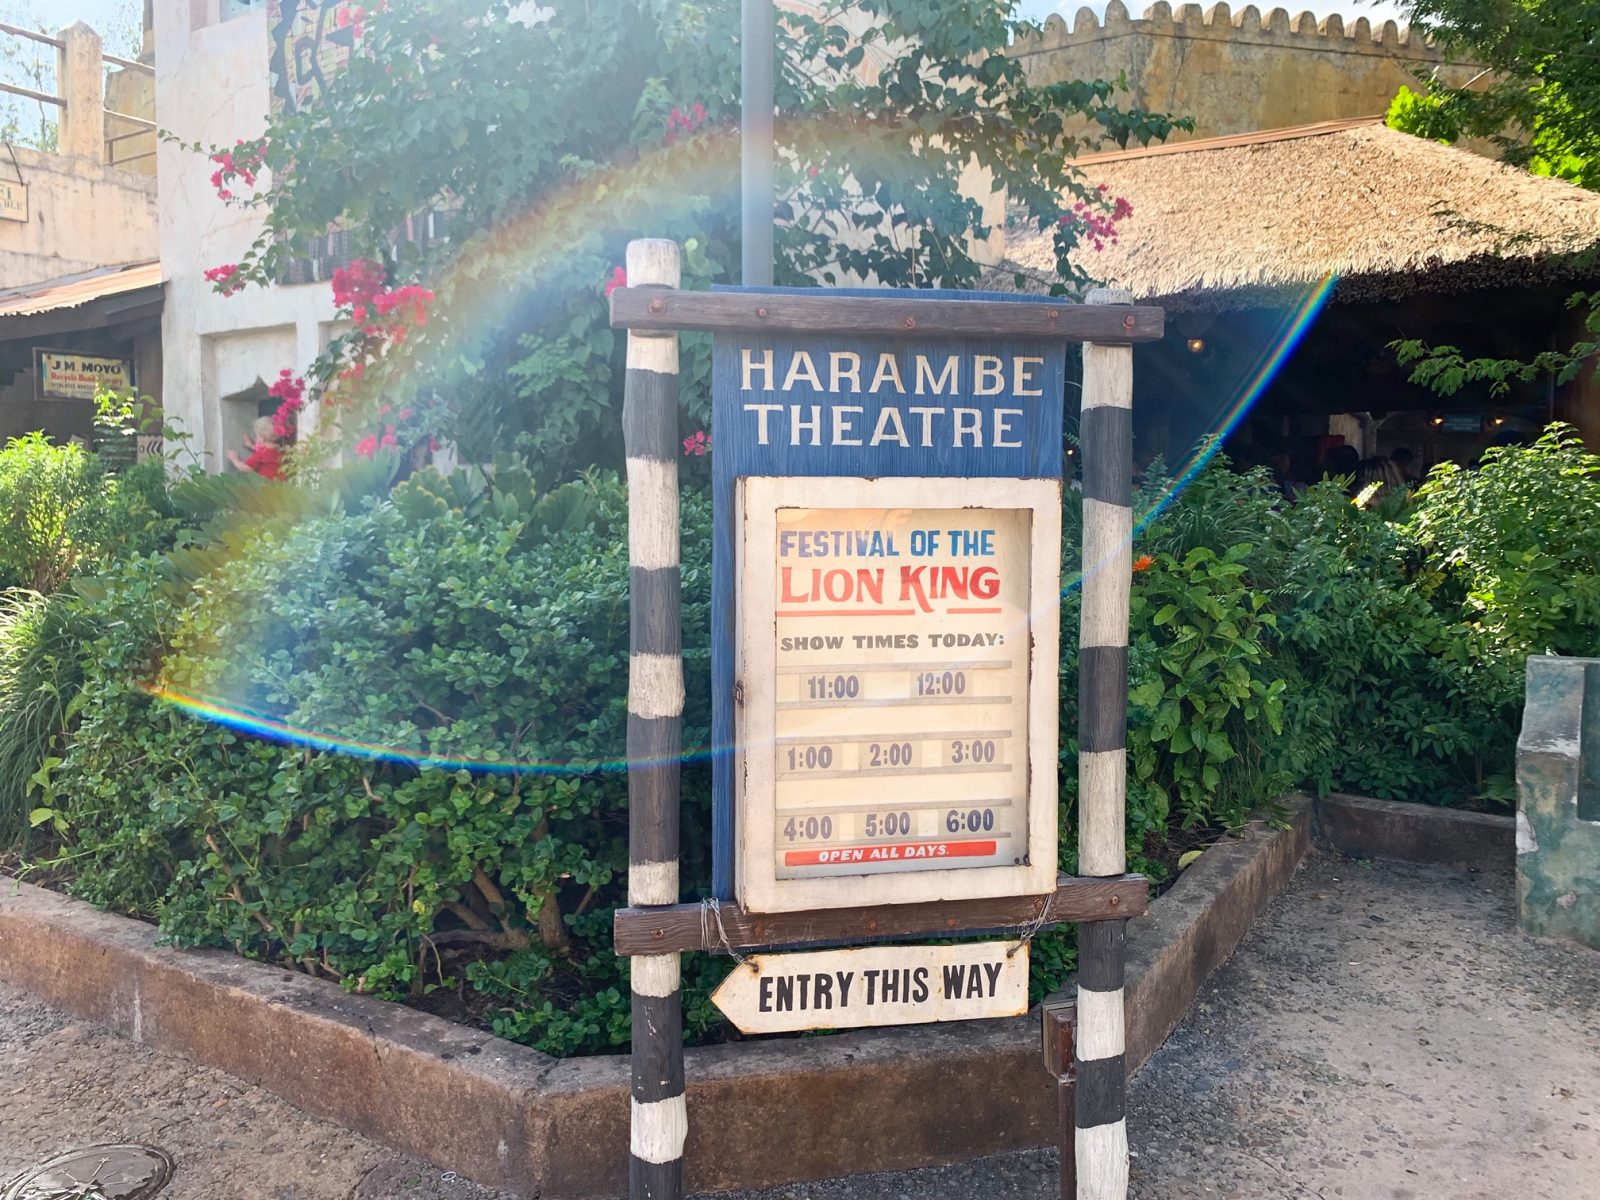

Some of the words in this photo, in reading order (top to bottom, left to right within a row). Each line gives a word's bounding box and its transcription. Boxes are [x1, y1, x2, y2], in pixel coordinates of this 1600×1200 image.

[81, 362, 122, 375] MOYO
[740, 349, 1045, 396] HARAMBE
[743, 404, 1024, 448] THEATRE
[780, 530, 899, 557] FESTIVAL
[910, 530, 941, 556] OF
[948, 529, 996, 557] THE
[780, 566, 885, 604] LION
[899, 565, 1001, 613] KING
[780, 635, 844, 651] SHOW
[852, 634, 919, 649] TIMES
[928, 633, 1005, 648] TODAY:
[807, 675, 860, 699] 11:00
[917, 671, 966, 696] 12:00
[787, 745, 833, 770] 1:00
[869, 742, 913, 767] 2:00
[951, 740, 995, 764] 3:00
[784, 815, 833, 841] 4:00
[864, 811, 911, 837] 5:00
[946, 808, 994, 833] 6:00
[818, 848, 864, 863] OPEN
[870, 845, 899, 859] ALL
[758, 971, 855, 1013] ENTRY
[863, 967, 930, 1005] THIS
[943, 962, 1003, 1000] WAY
